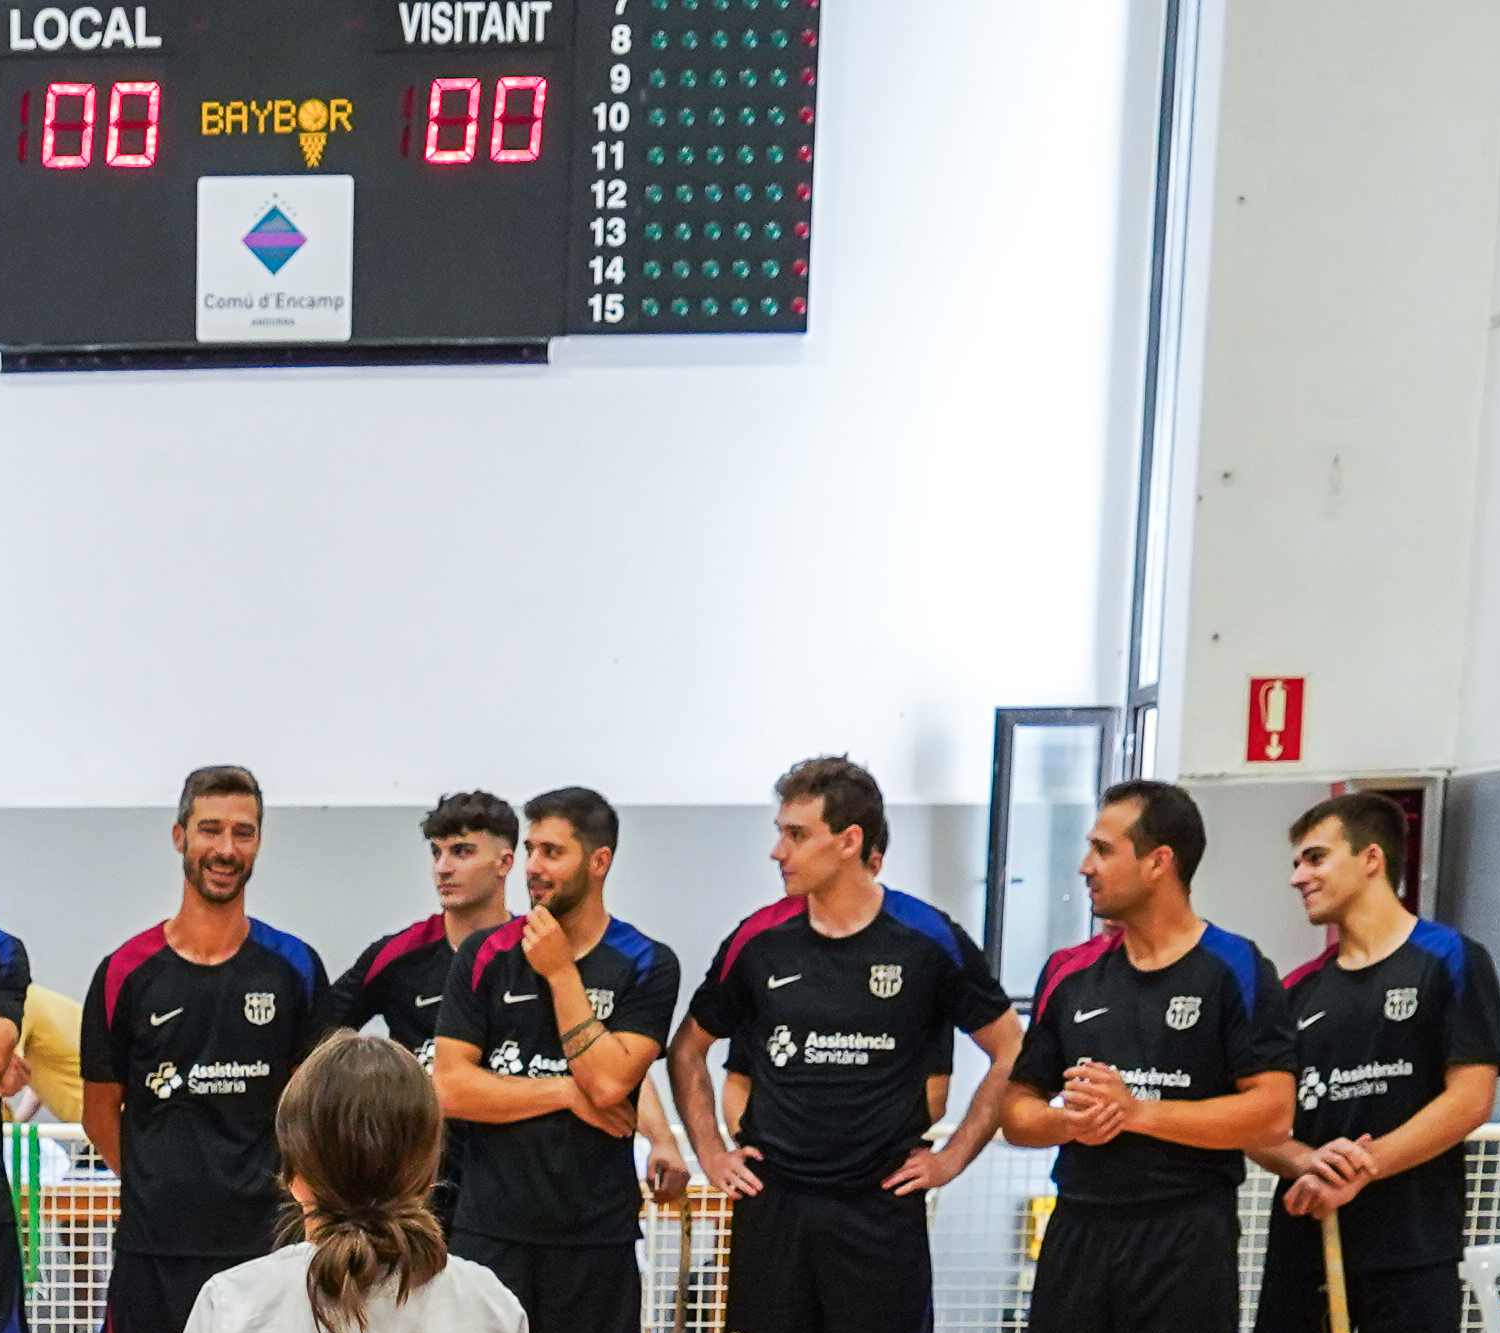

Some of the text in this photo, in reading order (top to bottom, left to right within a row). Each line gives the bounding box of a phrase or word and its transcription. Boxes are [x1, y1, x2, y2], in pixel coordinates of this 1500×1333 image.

[9, 7, 163, 51] LOCAL
[398, 1, 553, 45] VISITANT
[610, 23, 632, 55] 8
[609, 63, 631, 94] 9
[41, 81, 161, 170] 00
[423, 76, 549, 165] 00
[592, 101, 630, 132] 10
[591, 140, 625, 171] 11
[590, 178, 628, 209] 12
[589, 216, 627, 247] 13
[588, 255, 626, 285] 14
[587, 293, 625, 324] 15
[804, 1030, 896, 1051] Assistència
[187, 1060, 270, 1079] Assistència
[1328, 1058, 1414, 1084] Assistència
